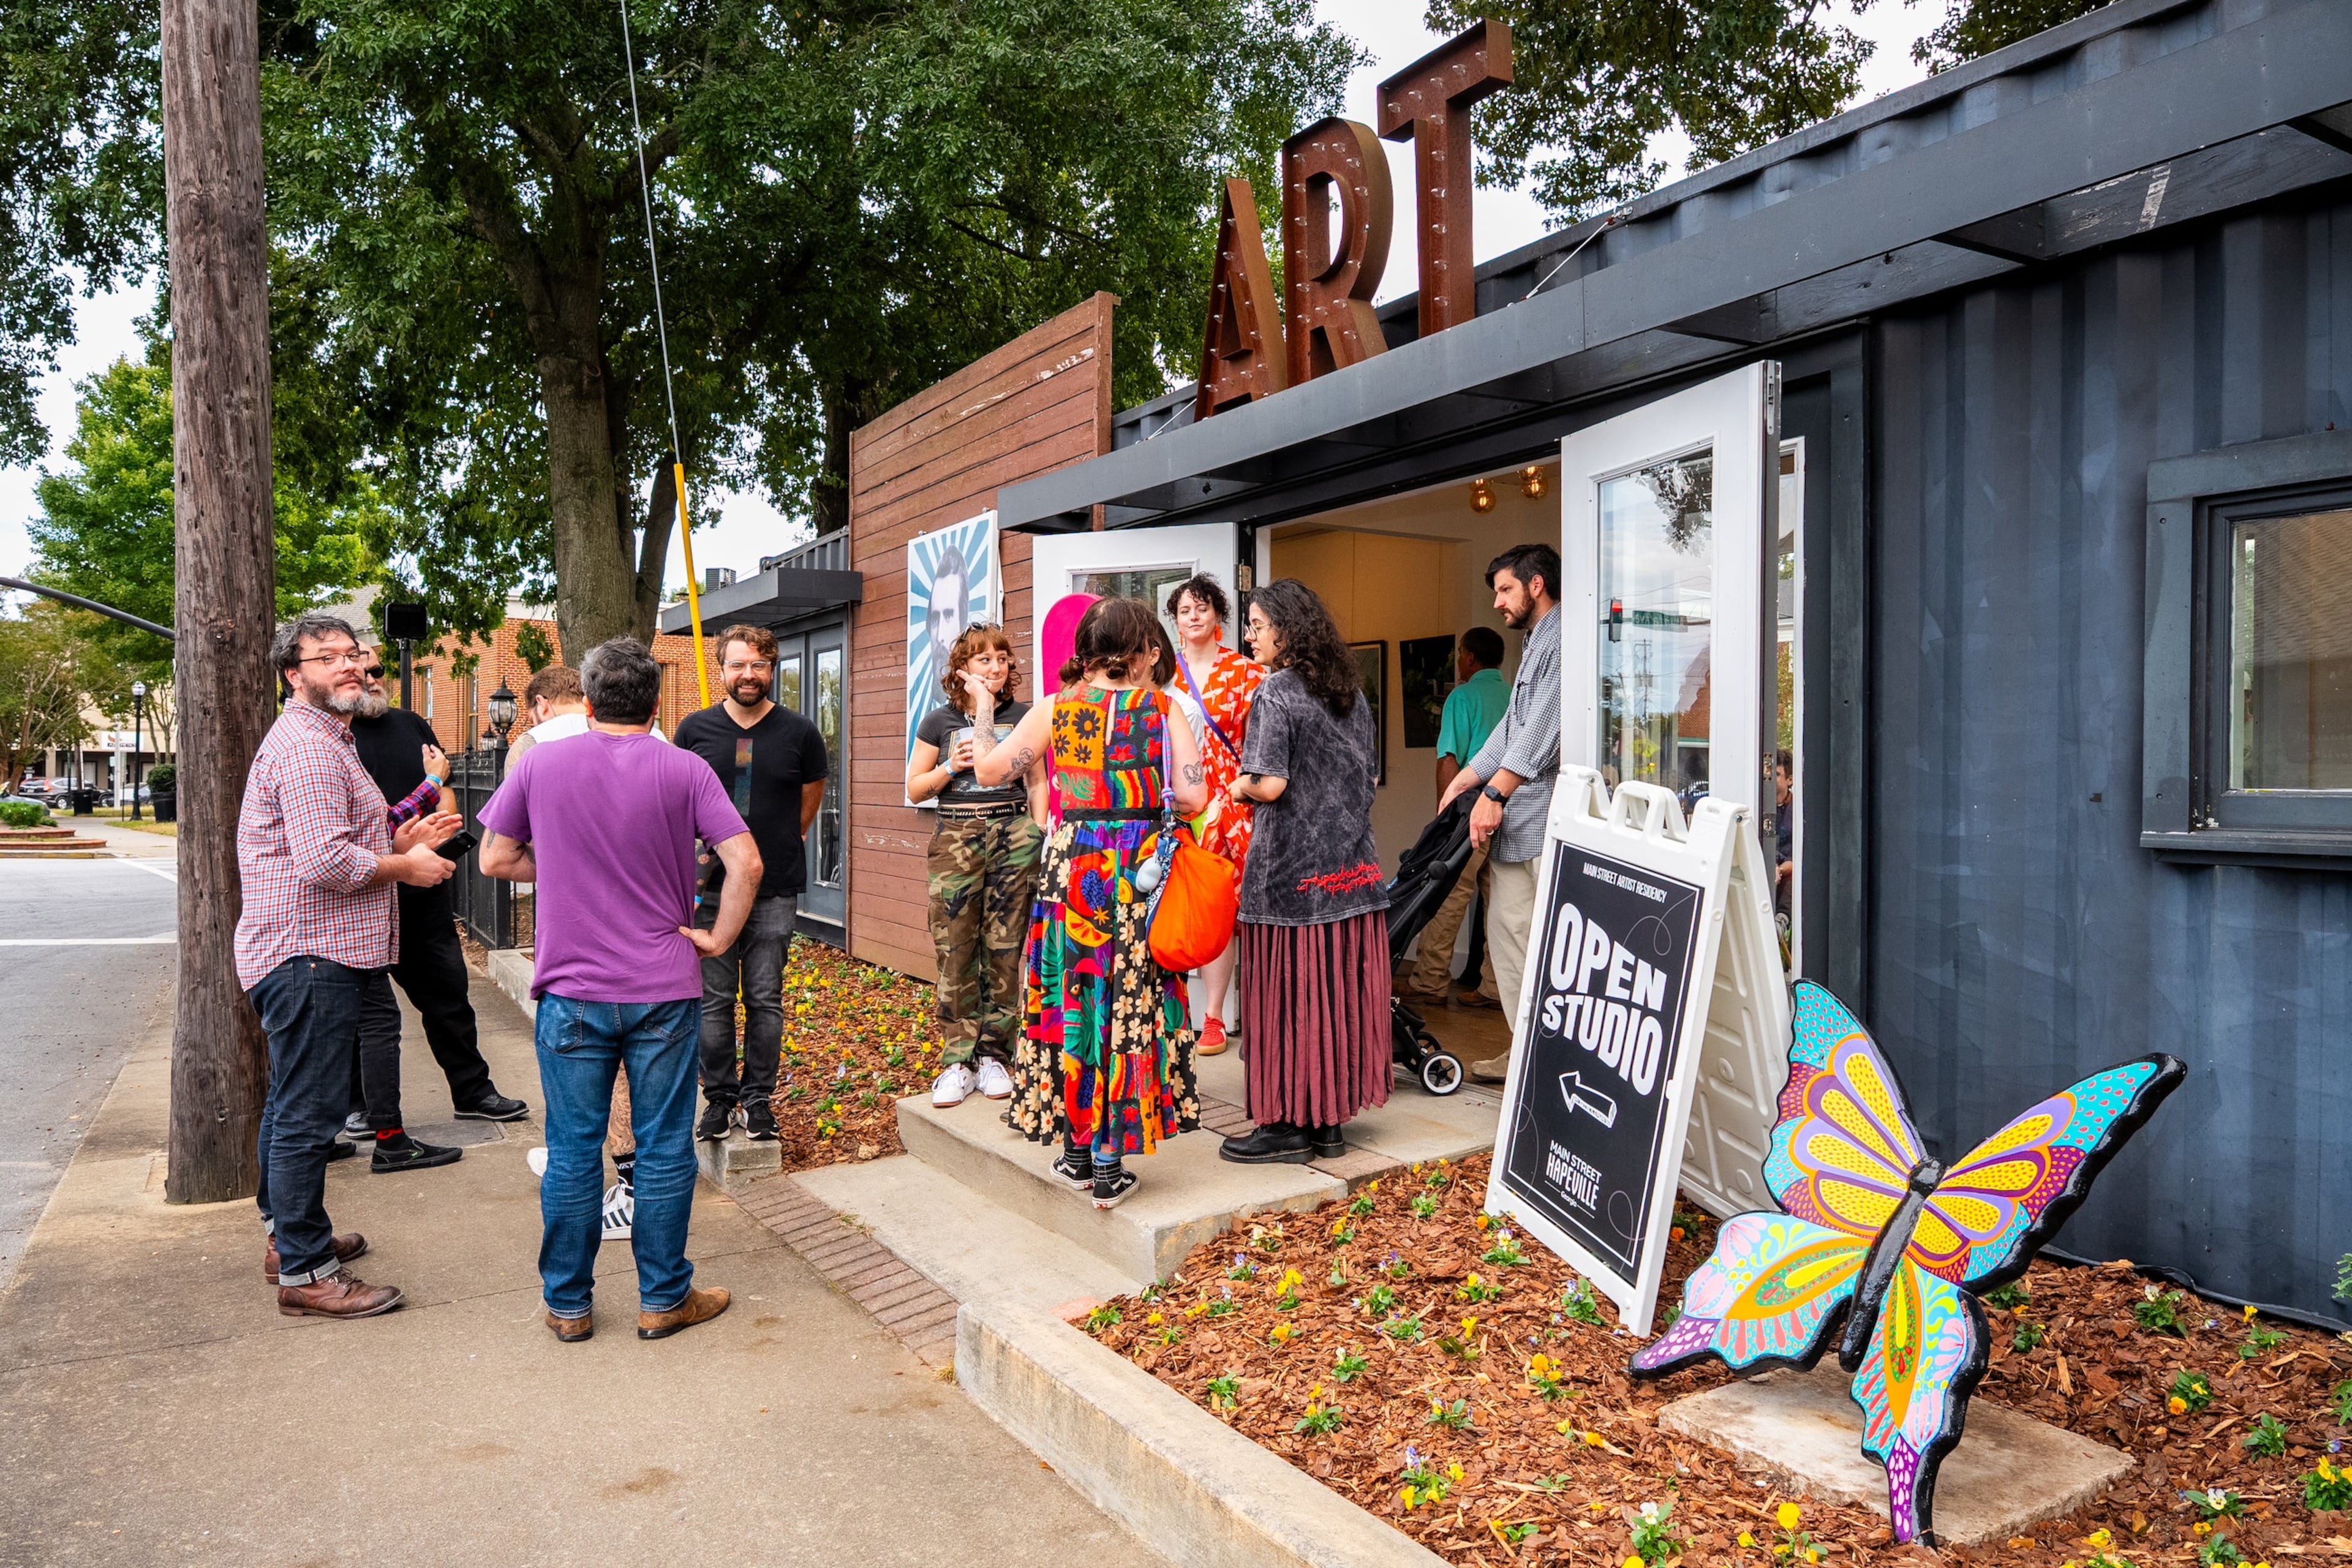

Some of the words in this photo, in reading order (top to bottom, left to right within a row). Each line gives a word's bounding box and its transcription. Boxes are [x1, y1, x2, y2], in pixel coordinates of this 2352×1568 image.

[1194, 19, 1513, 422] ART
[1583, 862, 1598, 878] MAIN
[1597, 867, 1618, 885] STREET
[1616, 875, 1637, 892] ARTIST
[1635, 881, 1667, 903] RESIDENCY
[1550, 903, 1667, 1012] OPEN
[1542, 995, 1663, 1096] STUDIO
[1546, 1152, 1599, 1210] HAPEVILLE
[1550, 1139, 1570, 1163] MAIN
[1570, 1154, 1602, 1184] STREET
[1560, 1191, 1577, 1207] Georgia
